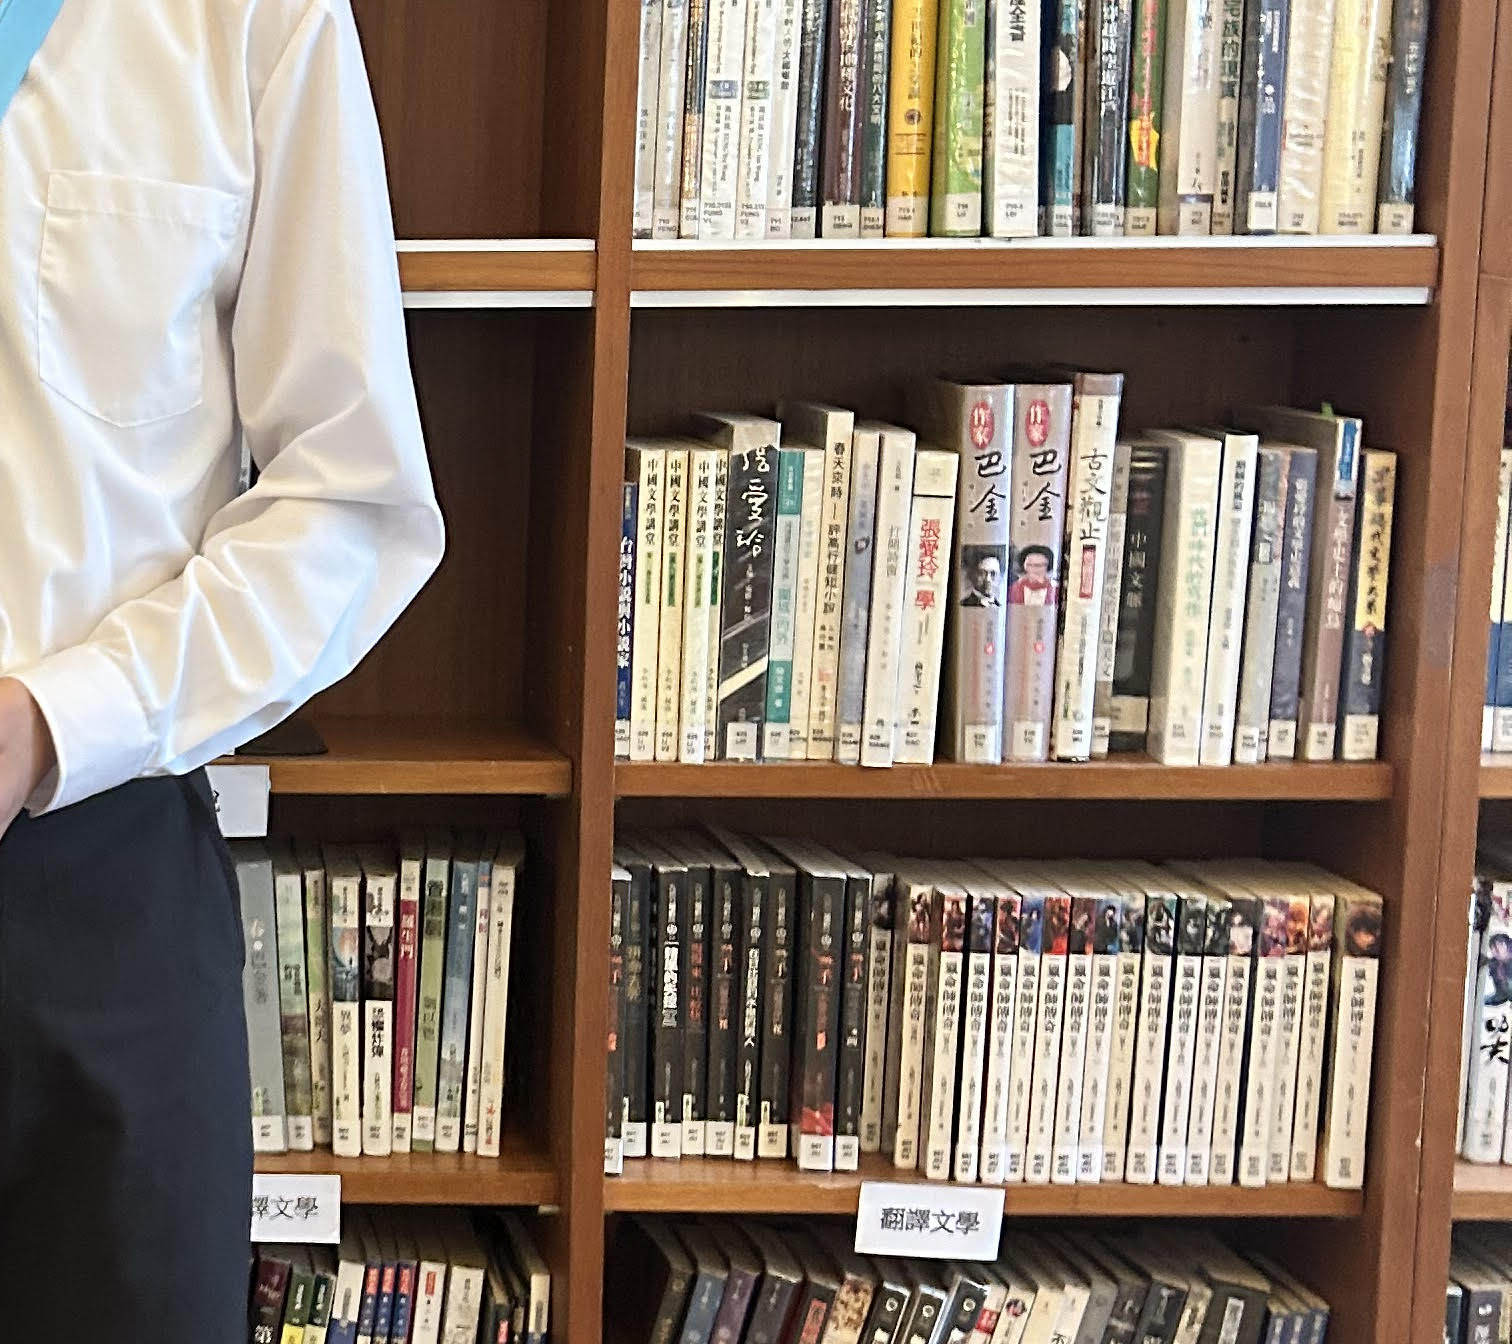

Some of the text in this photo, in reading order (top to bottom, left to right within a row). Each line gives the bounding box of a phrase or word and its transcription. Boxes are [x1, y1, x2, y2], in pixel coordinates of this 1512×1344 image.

[970, 452, 1007, 522] 巴金
[1024, 452, 1062, 522] 巴金
[1079, 447, 1108, 542] 古文觀止
[880, 1206, 980, 1235] 翻譯文學
